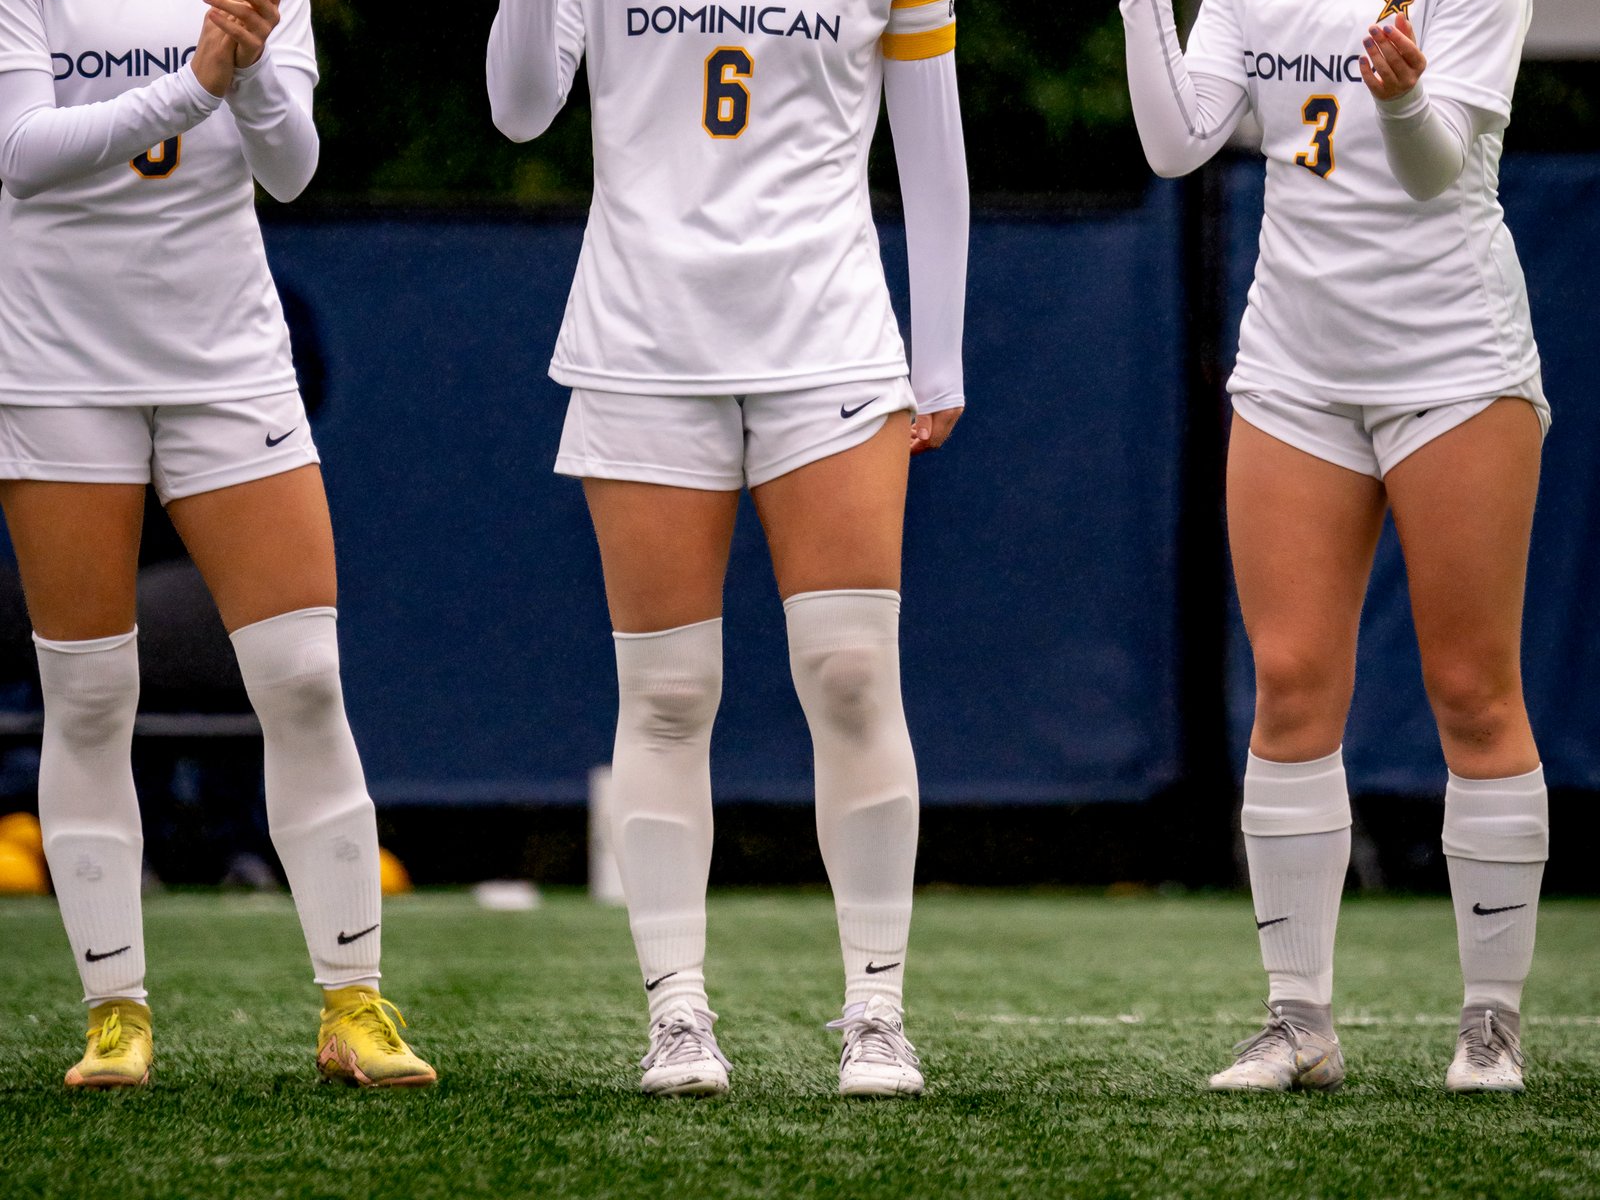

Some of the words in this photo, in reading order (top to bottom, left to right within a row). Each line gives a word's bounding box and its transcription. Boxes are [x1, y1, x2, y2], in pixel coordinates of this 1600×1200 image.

[626, 5, 841, 43] DOMINICAN
[701, 45, 755, 140] 6
[1293, 93, 1341, 180] 3
